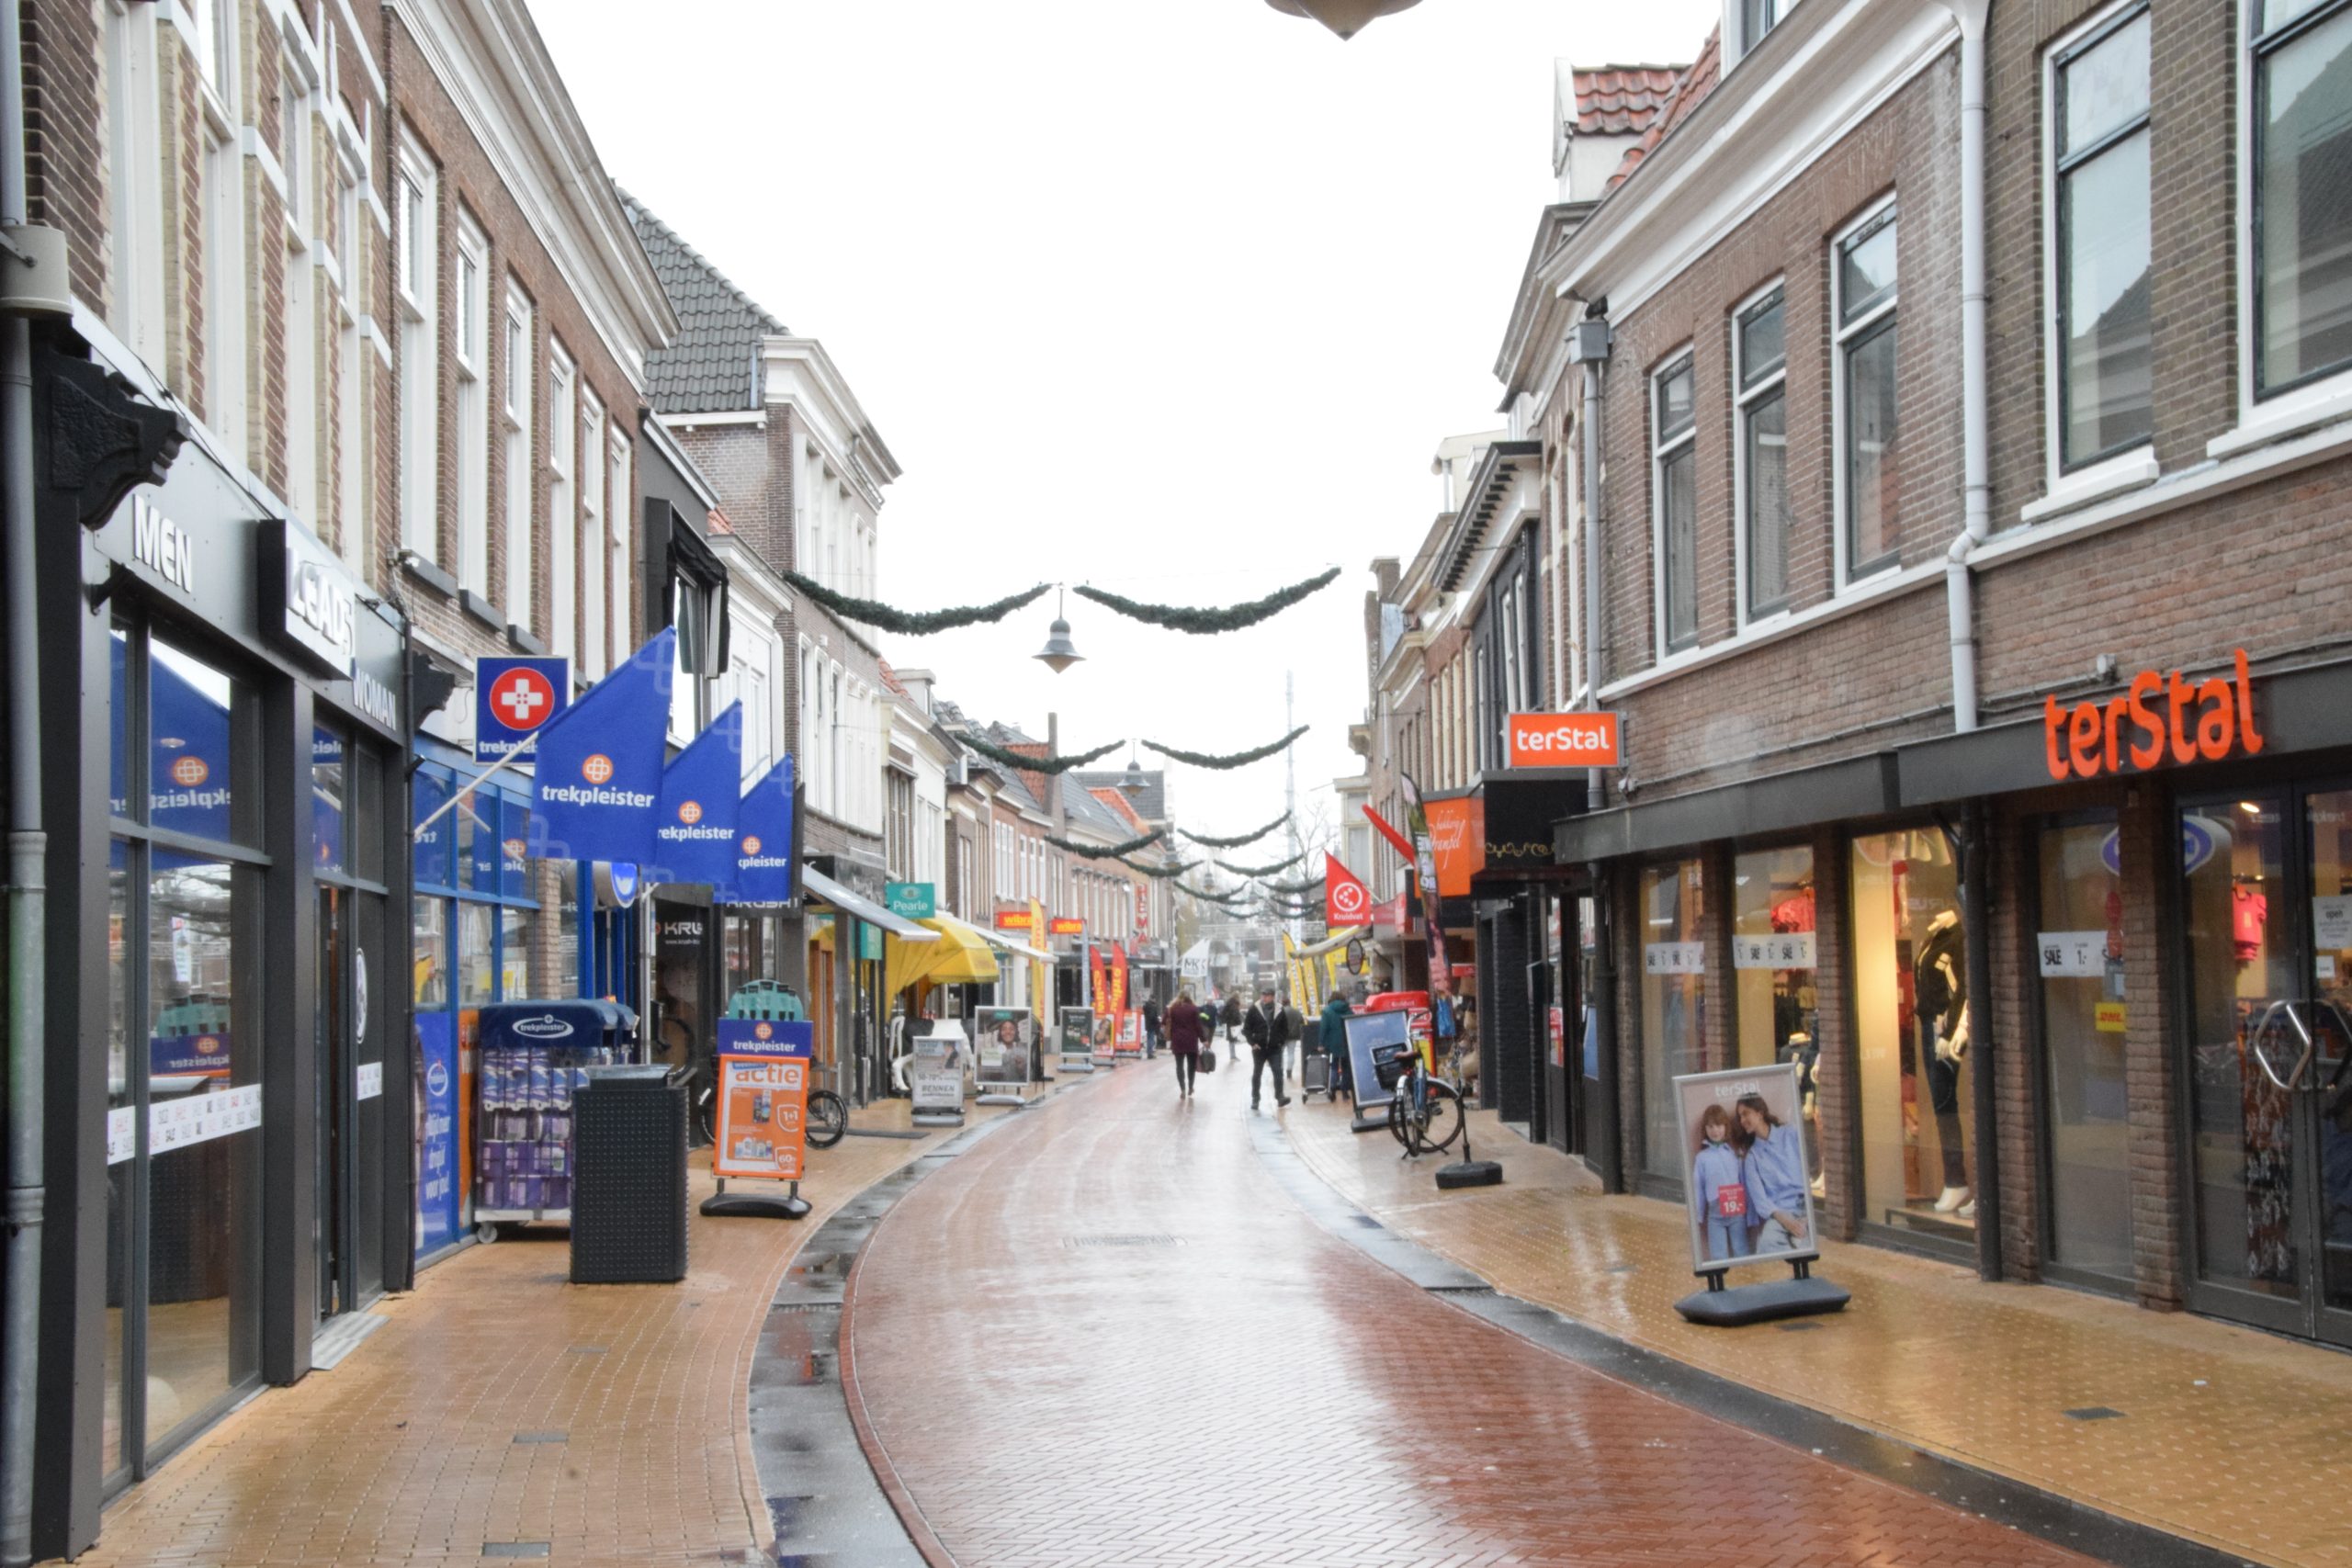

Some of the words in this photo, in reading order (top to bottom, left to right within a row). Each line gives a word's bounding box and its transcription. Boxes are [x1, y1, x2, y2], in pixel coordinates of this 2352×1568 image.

[132, 493, 193, 593] MEN
[352, 667, 397, 732] WOMAN
[2044, 648, 2263, 780] terStal
[1516, 726, 1610, 750] terStal
[542, 785, 654, 807] trekpleister
[658, 825, 734, 842] rekpleister
[893, 900, 928, 911] Pearle
[2044, 949, 2062, 965] SALE
[520, 1023, 565, 1032] trekpleister
[733, 1040, 797, 1053] trekpleister
